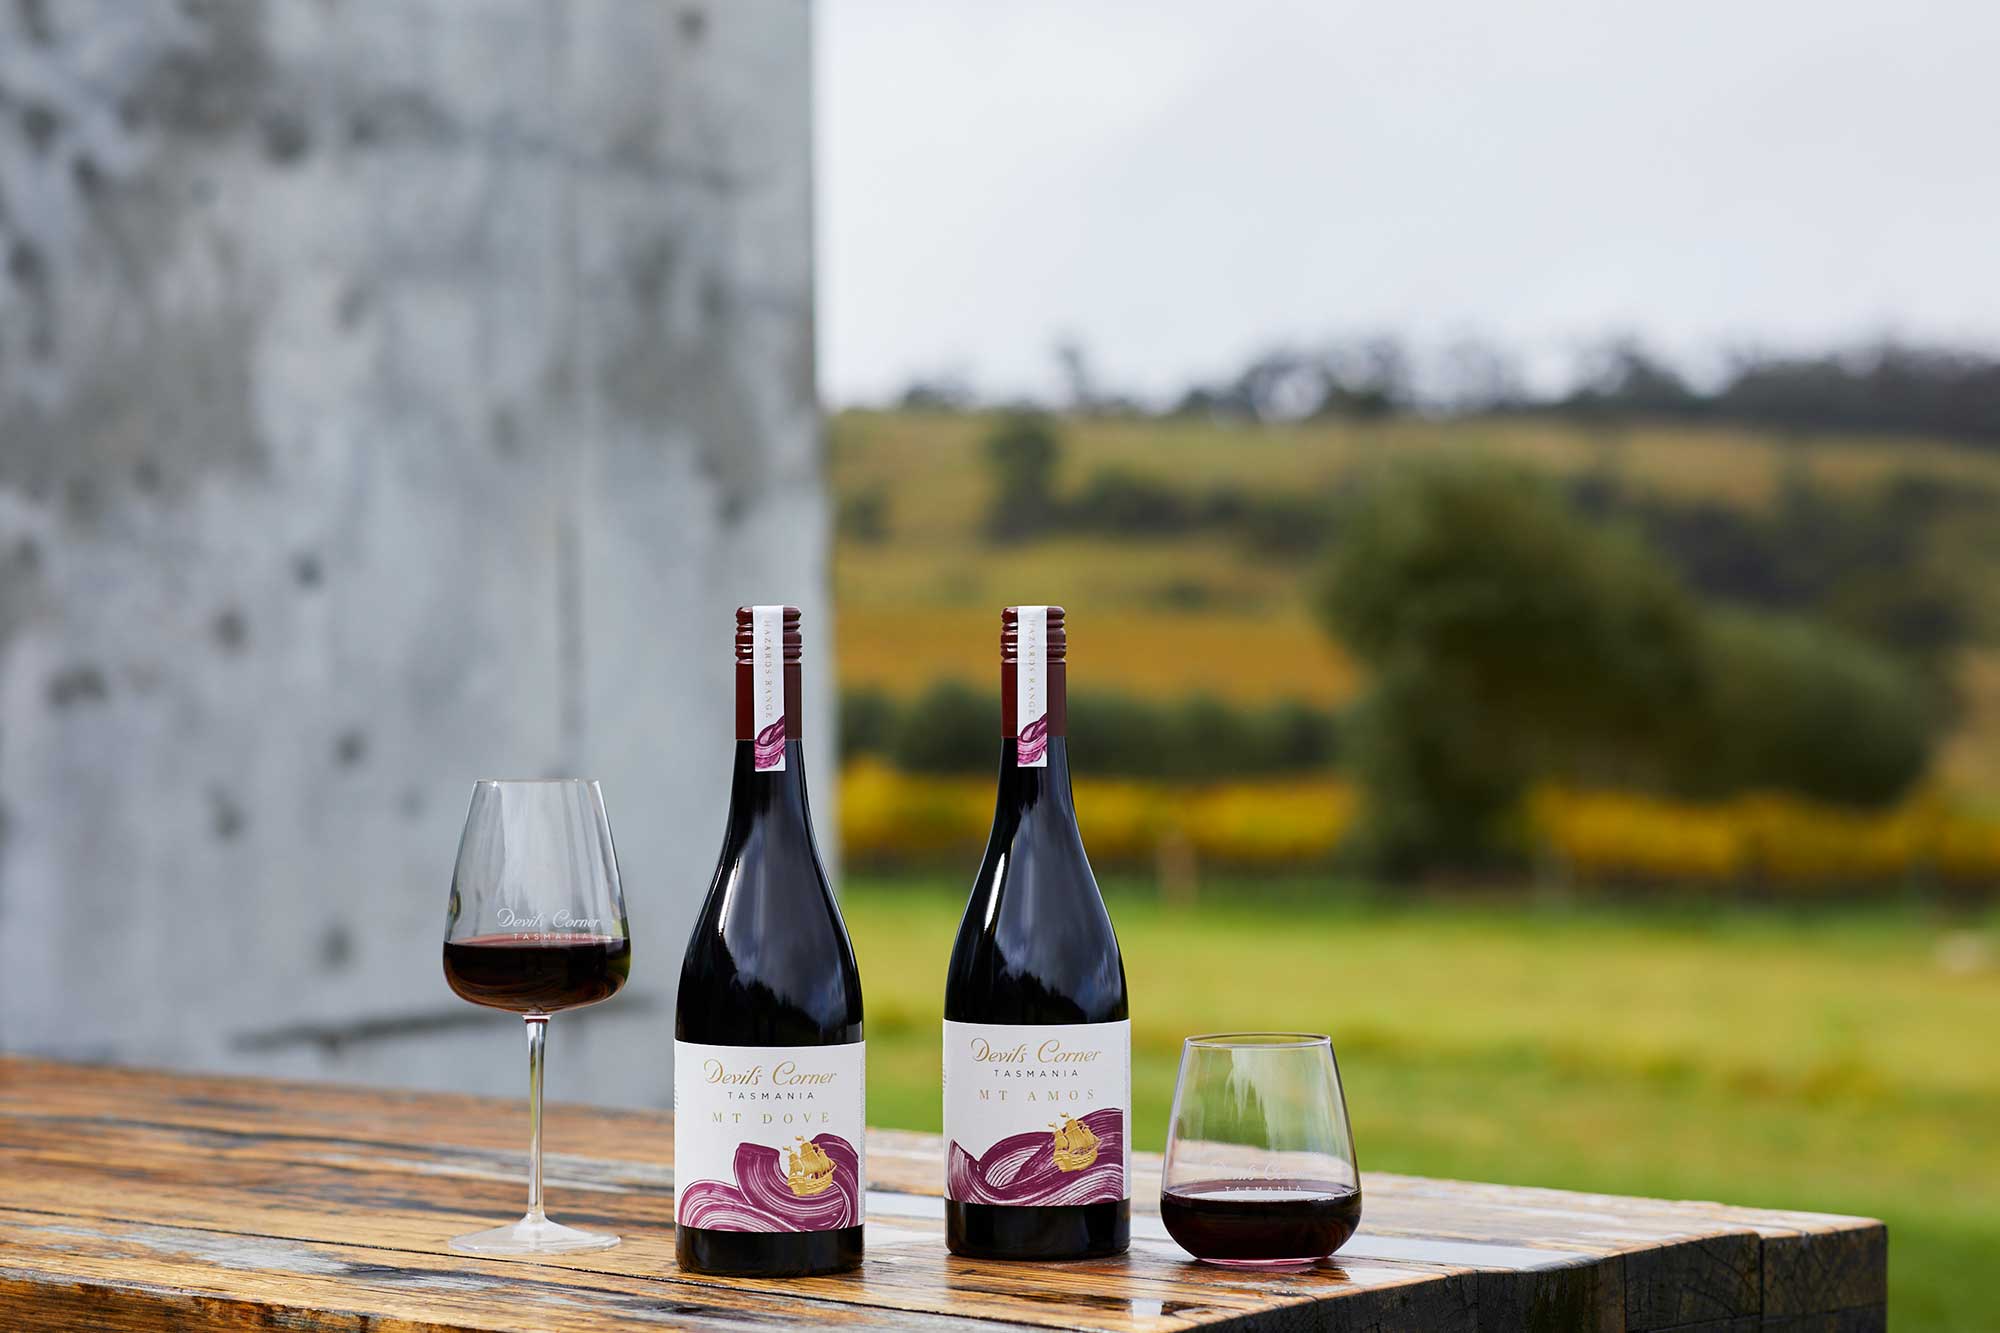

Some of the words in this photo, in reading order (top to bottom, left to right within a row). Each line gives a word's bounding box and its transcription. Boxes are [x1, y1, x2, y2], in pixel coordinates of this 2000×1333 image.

[552, 908, 600, 928] Corner
[513, 933, 588, 941] TASMANIA
[970, 1037, 1028, 1063] Devil's
[1037, 1039, 1102, 1064] Corner
[703, 1058, 763, 1086] Devil's
[772, 1060, 837, 1087] Corner
[994, 1069, 1079, 1078] TASMANIA
[728, 1091, 815, 1100] TASMANIA
[979, 1089, 1008, 1101] MT
[1027, 1089, 1095, 1102] AMOS
[712, 1111, 742, 1124] MT
[762, 1111, 829, 1125] DOVE
